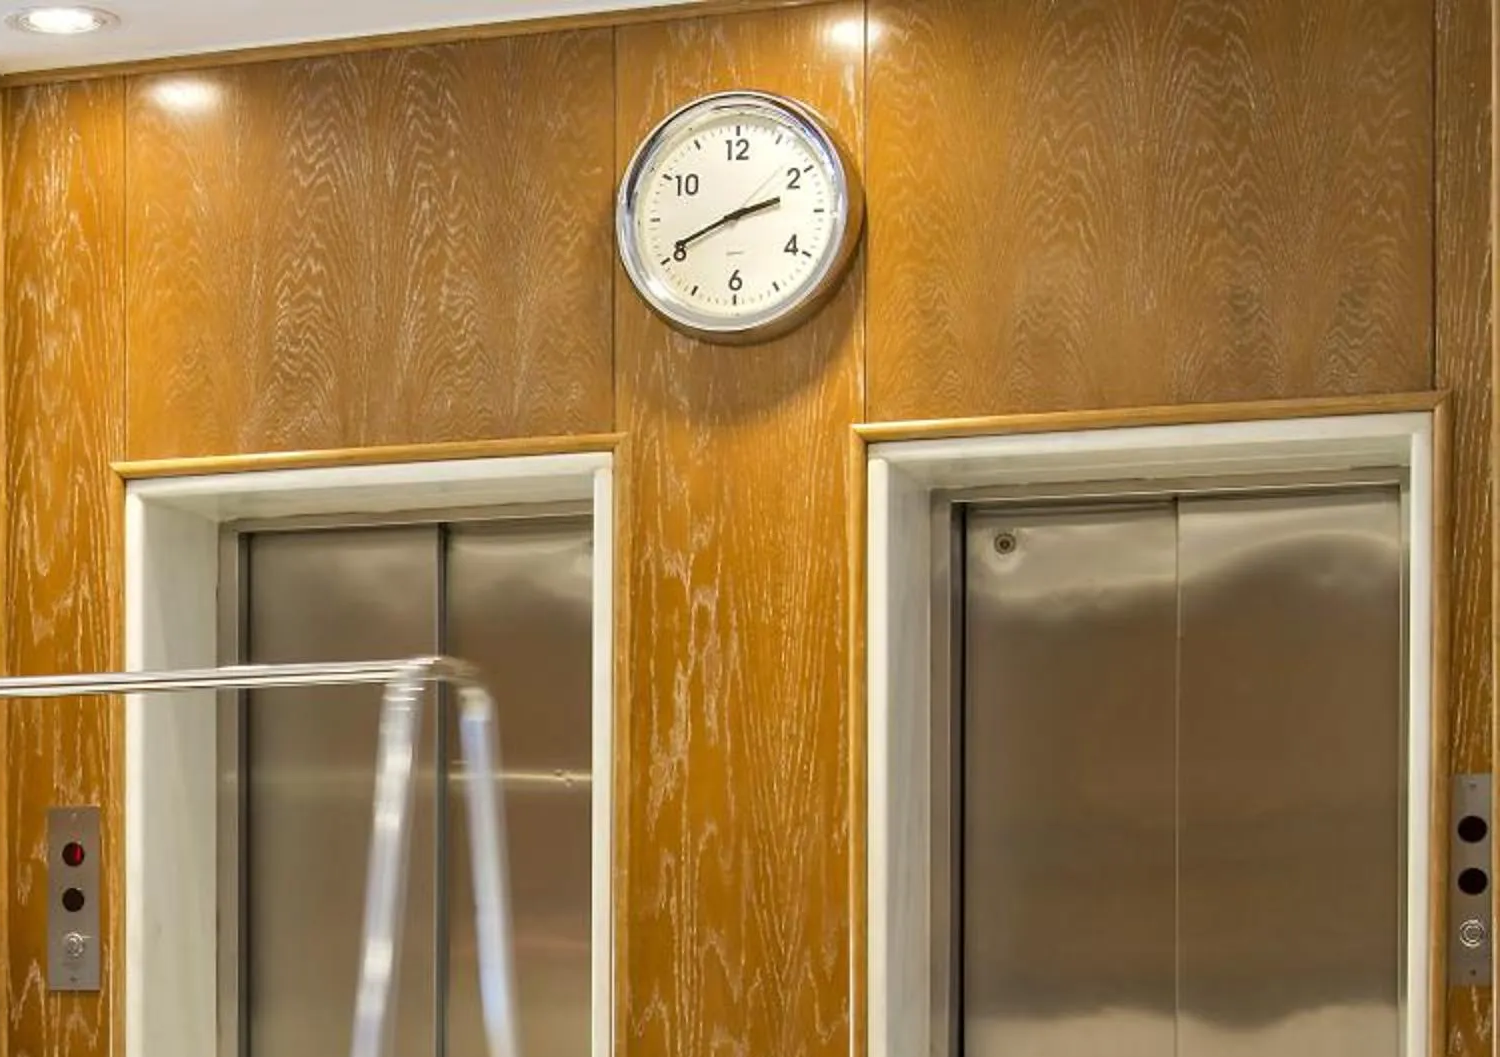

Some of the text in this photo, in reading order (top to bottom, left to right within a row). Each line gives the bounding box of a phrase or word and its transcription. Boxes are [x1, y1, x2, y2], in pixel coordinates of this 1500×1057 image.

[725, 139, 750, 161] 12
[675, 174, 699, 196] 10
[786, 168, 801, 189] 2
[673, 241, 687, 262] 8
[784, 234, 799, 256] 4
[728, 270, 743, 291] 6
